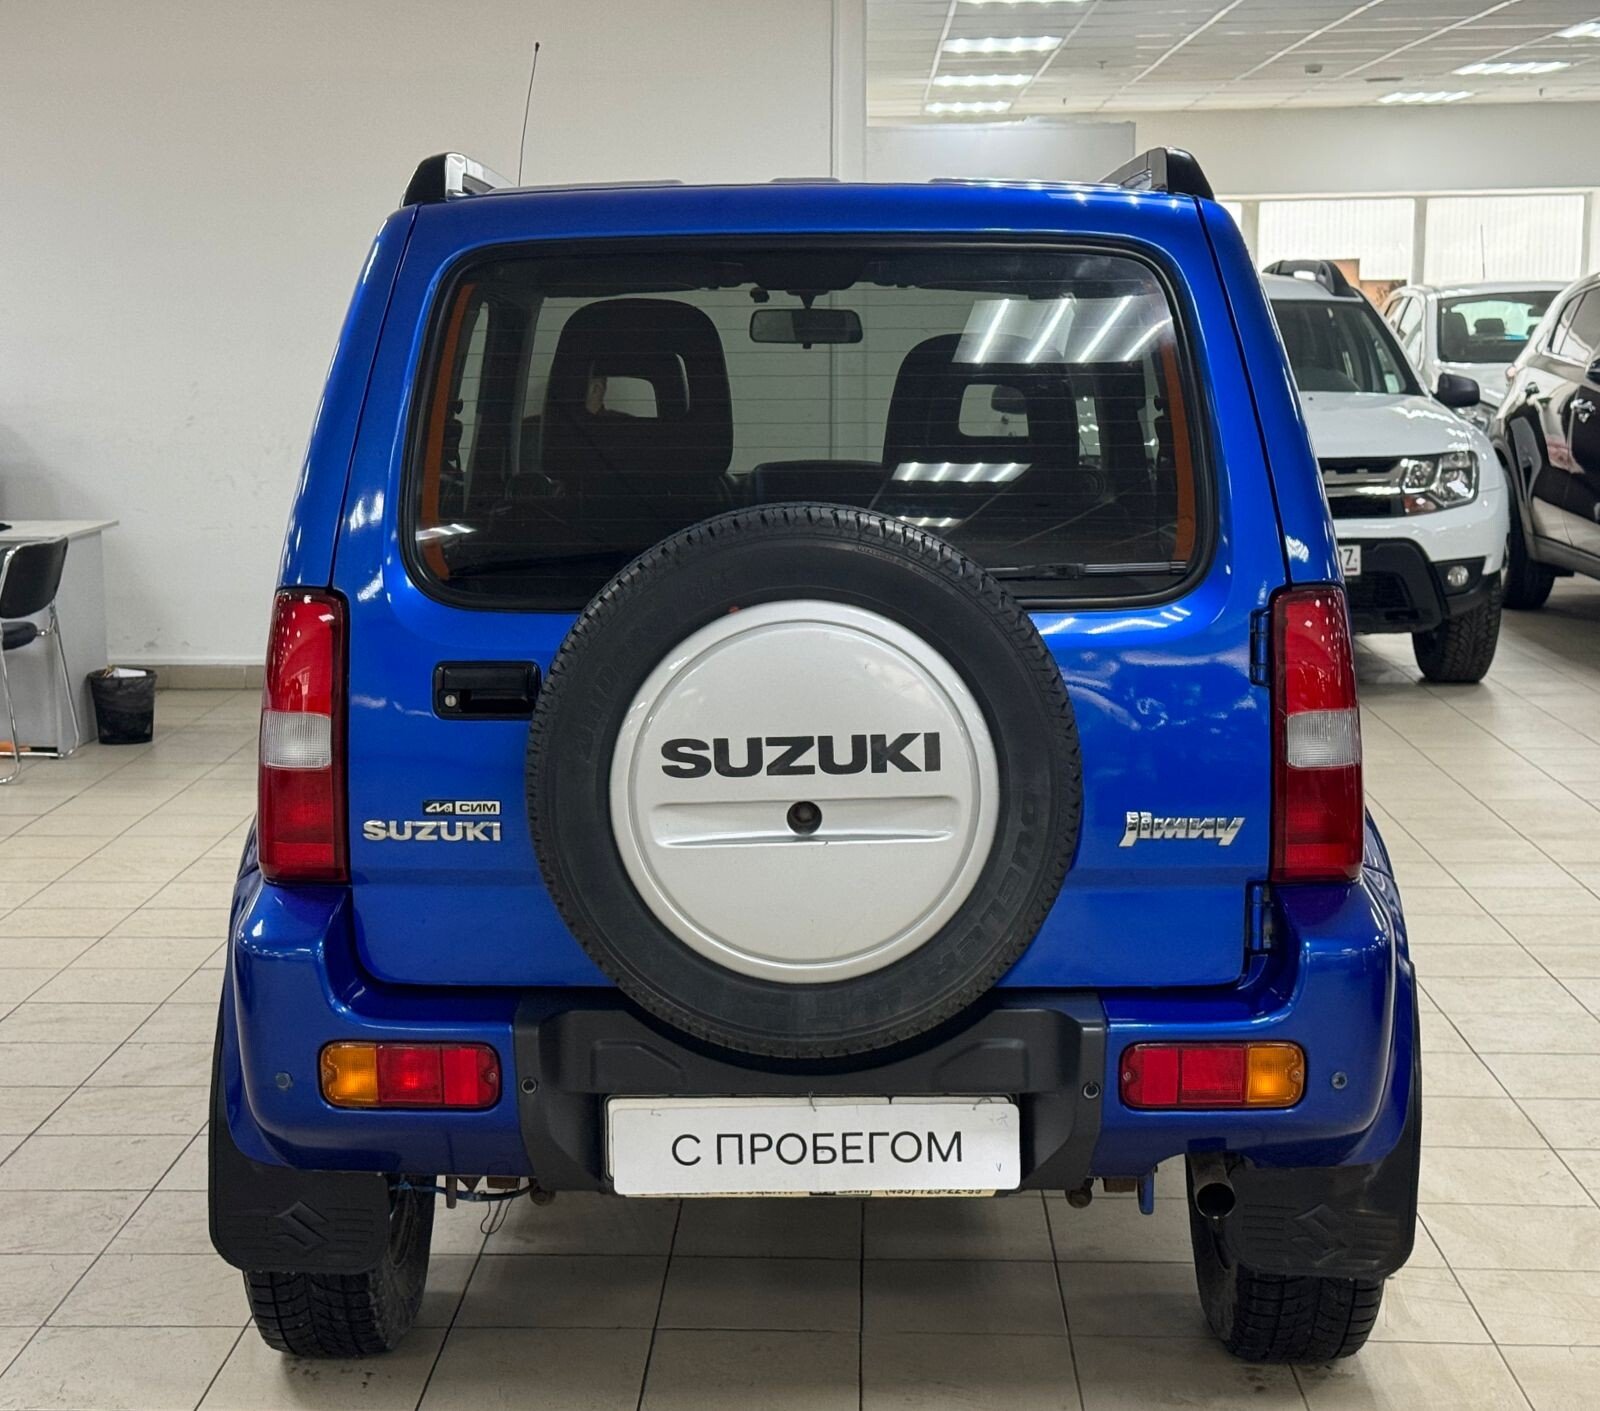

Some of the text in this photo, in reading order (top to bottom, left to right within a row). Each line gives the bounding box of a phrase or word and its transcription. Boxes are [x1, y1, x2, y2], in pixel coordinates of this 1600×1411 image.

[660, 731, 941, 779] SUZUKI
[459, 803, 497, 812] СИМ
[362, 819, 501, 842] SUZUKI
[671, 1130, 963, 1166] С ПРОБЕГОМ
